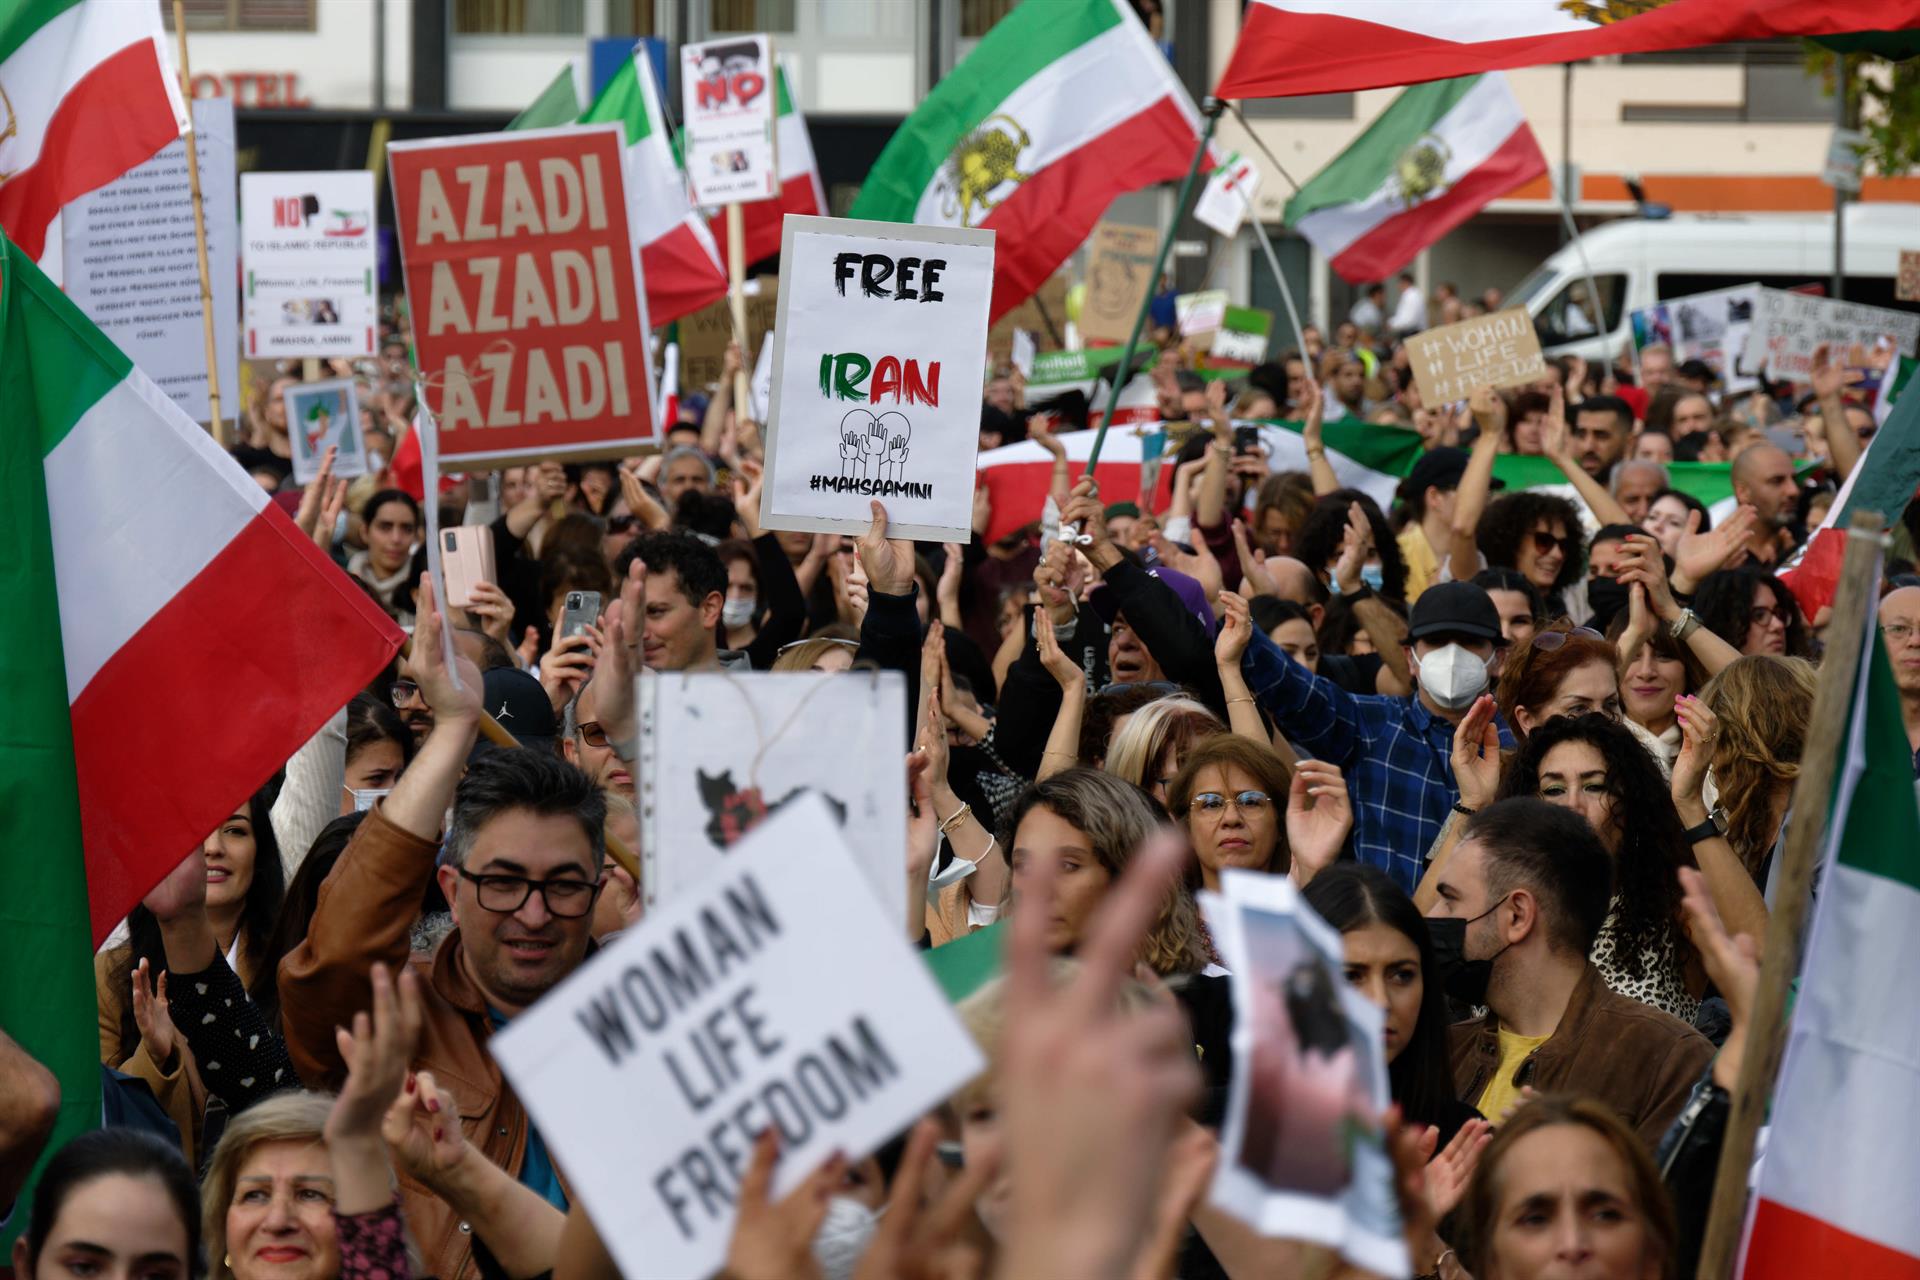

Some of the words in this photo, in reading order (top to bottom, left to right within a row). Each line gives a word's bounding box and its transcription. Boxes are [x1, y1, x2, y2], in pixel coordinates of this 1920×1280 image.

[178, 72, 312, 109] OTEL
[696, 72, 765, 110] NO
[274, 197, 300, 228] NO
[416, 153, 608, 246] AZADI
[428, 245, 620, 337] AZADI
[833, 253, 947, 303] FREE
[440, 340, 631, 432] AZADI
[819, 352, 940, 408] IRAN
[809, 475, 933, 500] #MAHSAAMINI
[575, 871, 782, 1066] WOMAN
[661, 983, 785, 1113] LIFE
[653, 1015, 902, 1241] FREEDOM
